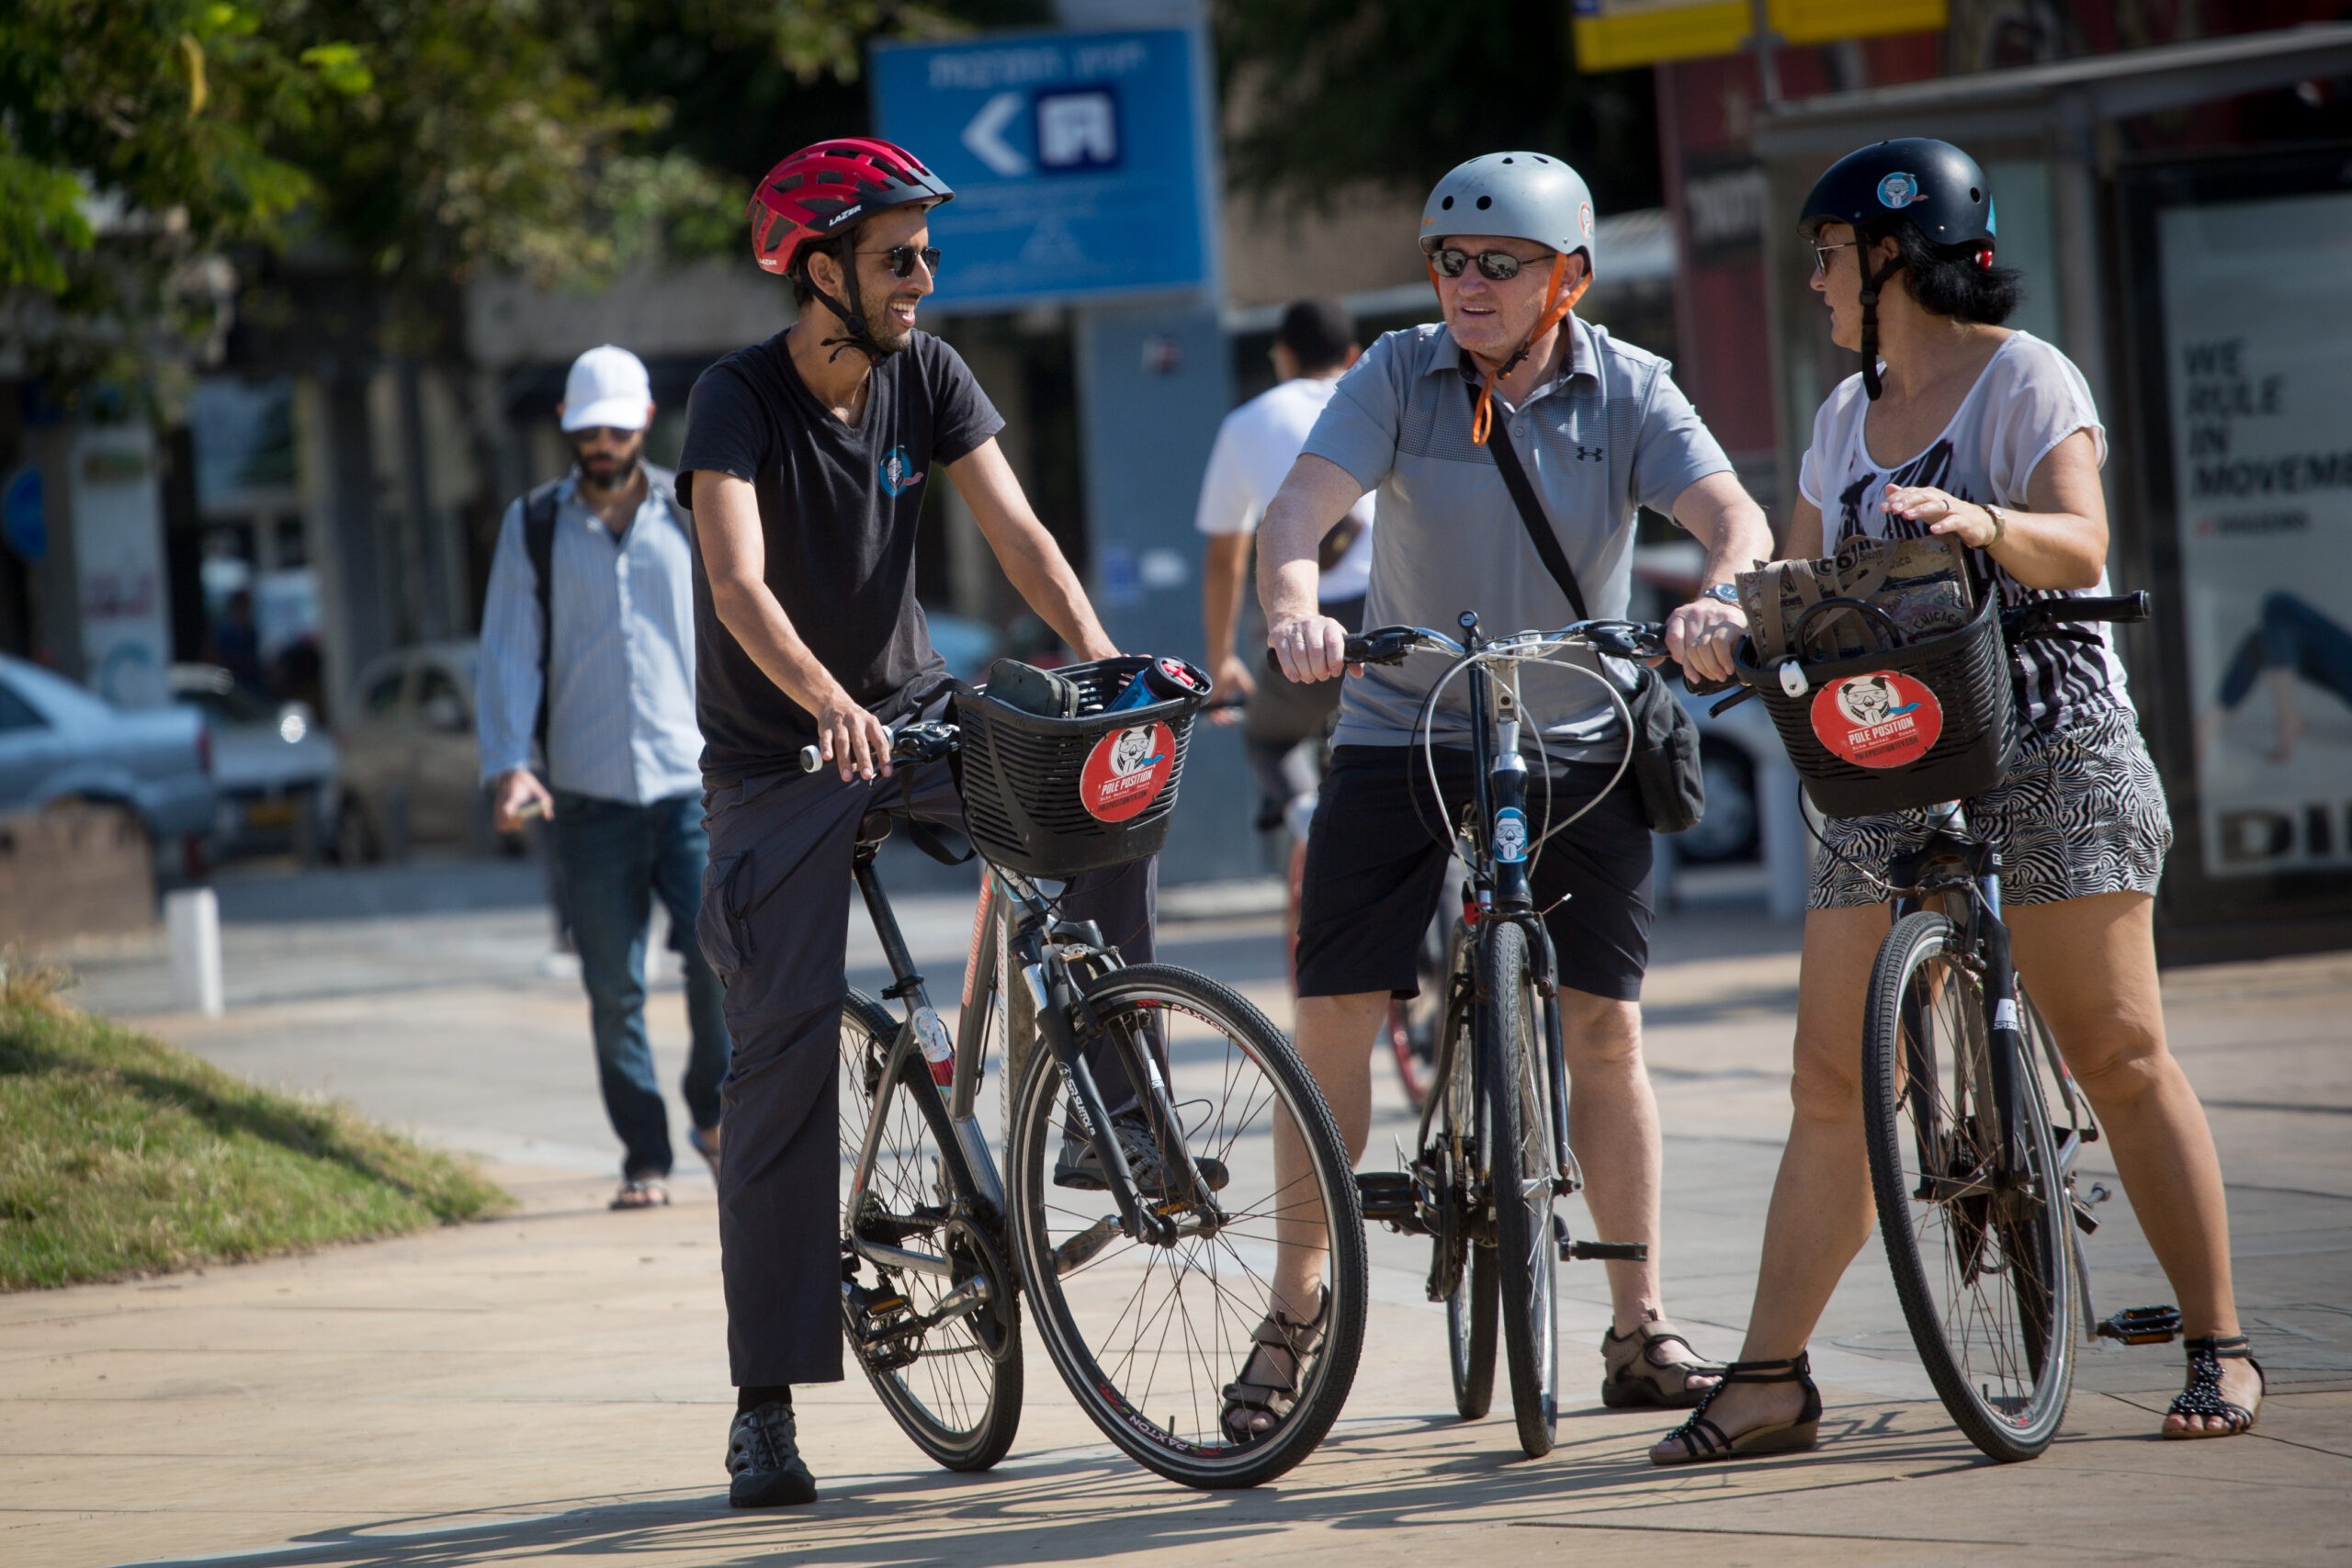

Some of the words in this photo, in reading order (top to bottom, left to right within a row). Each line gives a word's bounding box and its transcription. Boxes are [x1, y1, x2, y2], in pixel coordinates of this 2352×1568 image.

[829, 204, 862, 228] LAZER
[759, 257, 777, 266] LAZER
[2186, 339, 2245, 376] WE
[2189, 375, 2285, 418] RULE
[2189, 423, 2231, 457] IN
[1848, 730, 1871, 745] POLE
[1872, 716, 1915, 739] POSITION
[1101, 781, 1120, 795] POLE
[1120, 769, 1153, 790] POSITION
[1170, 1003, 1229, 1037] PAXTON
[1129, 1415, 1189, 1450] PAXTON
